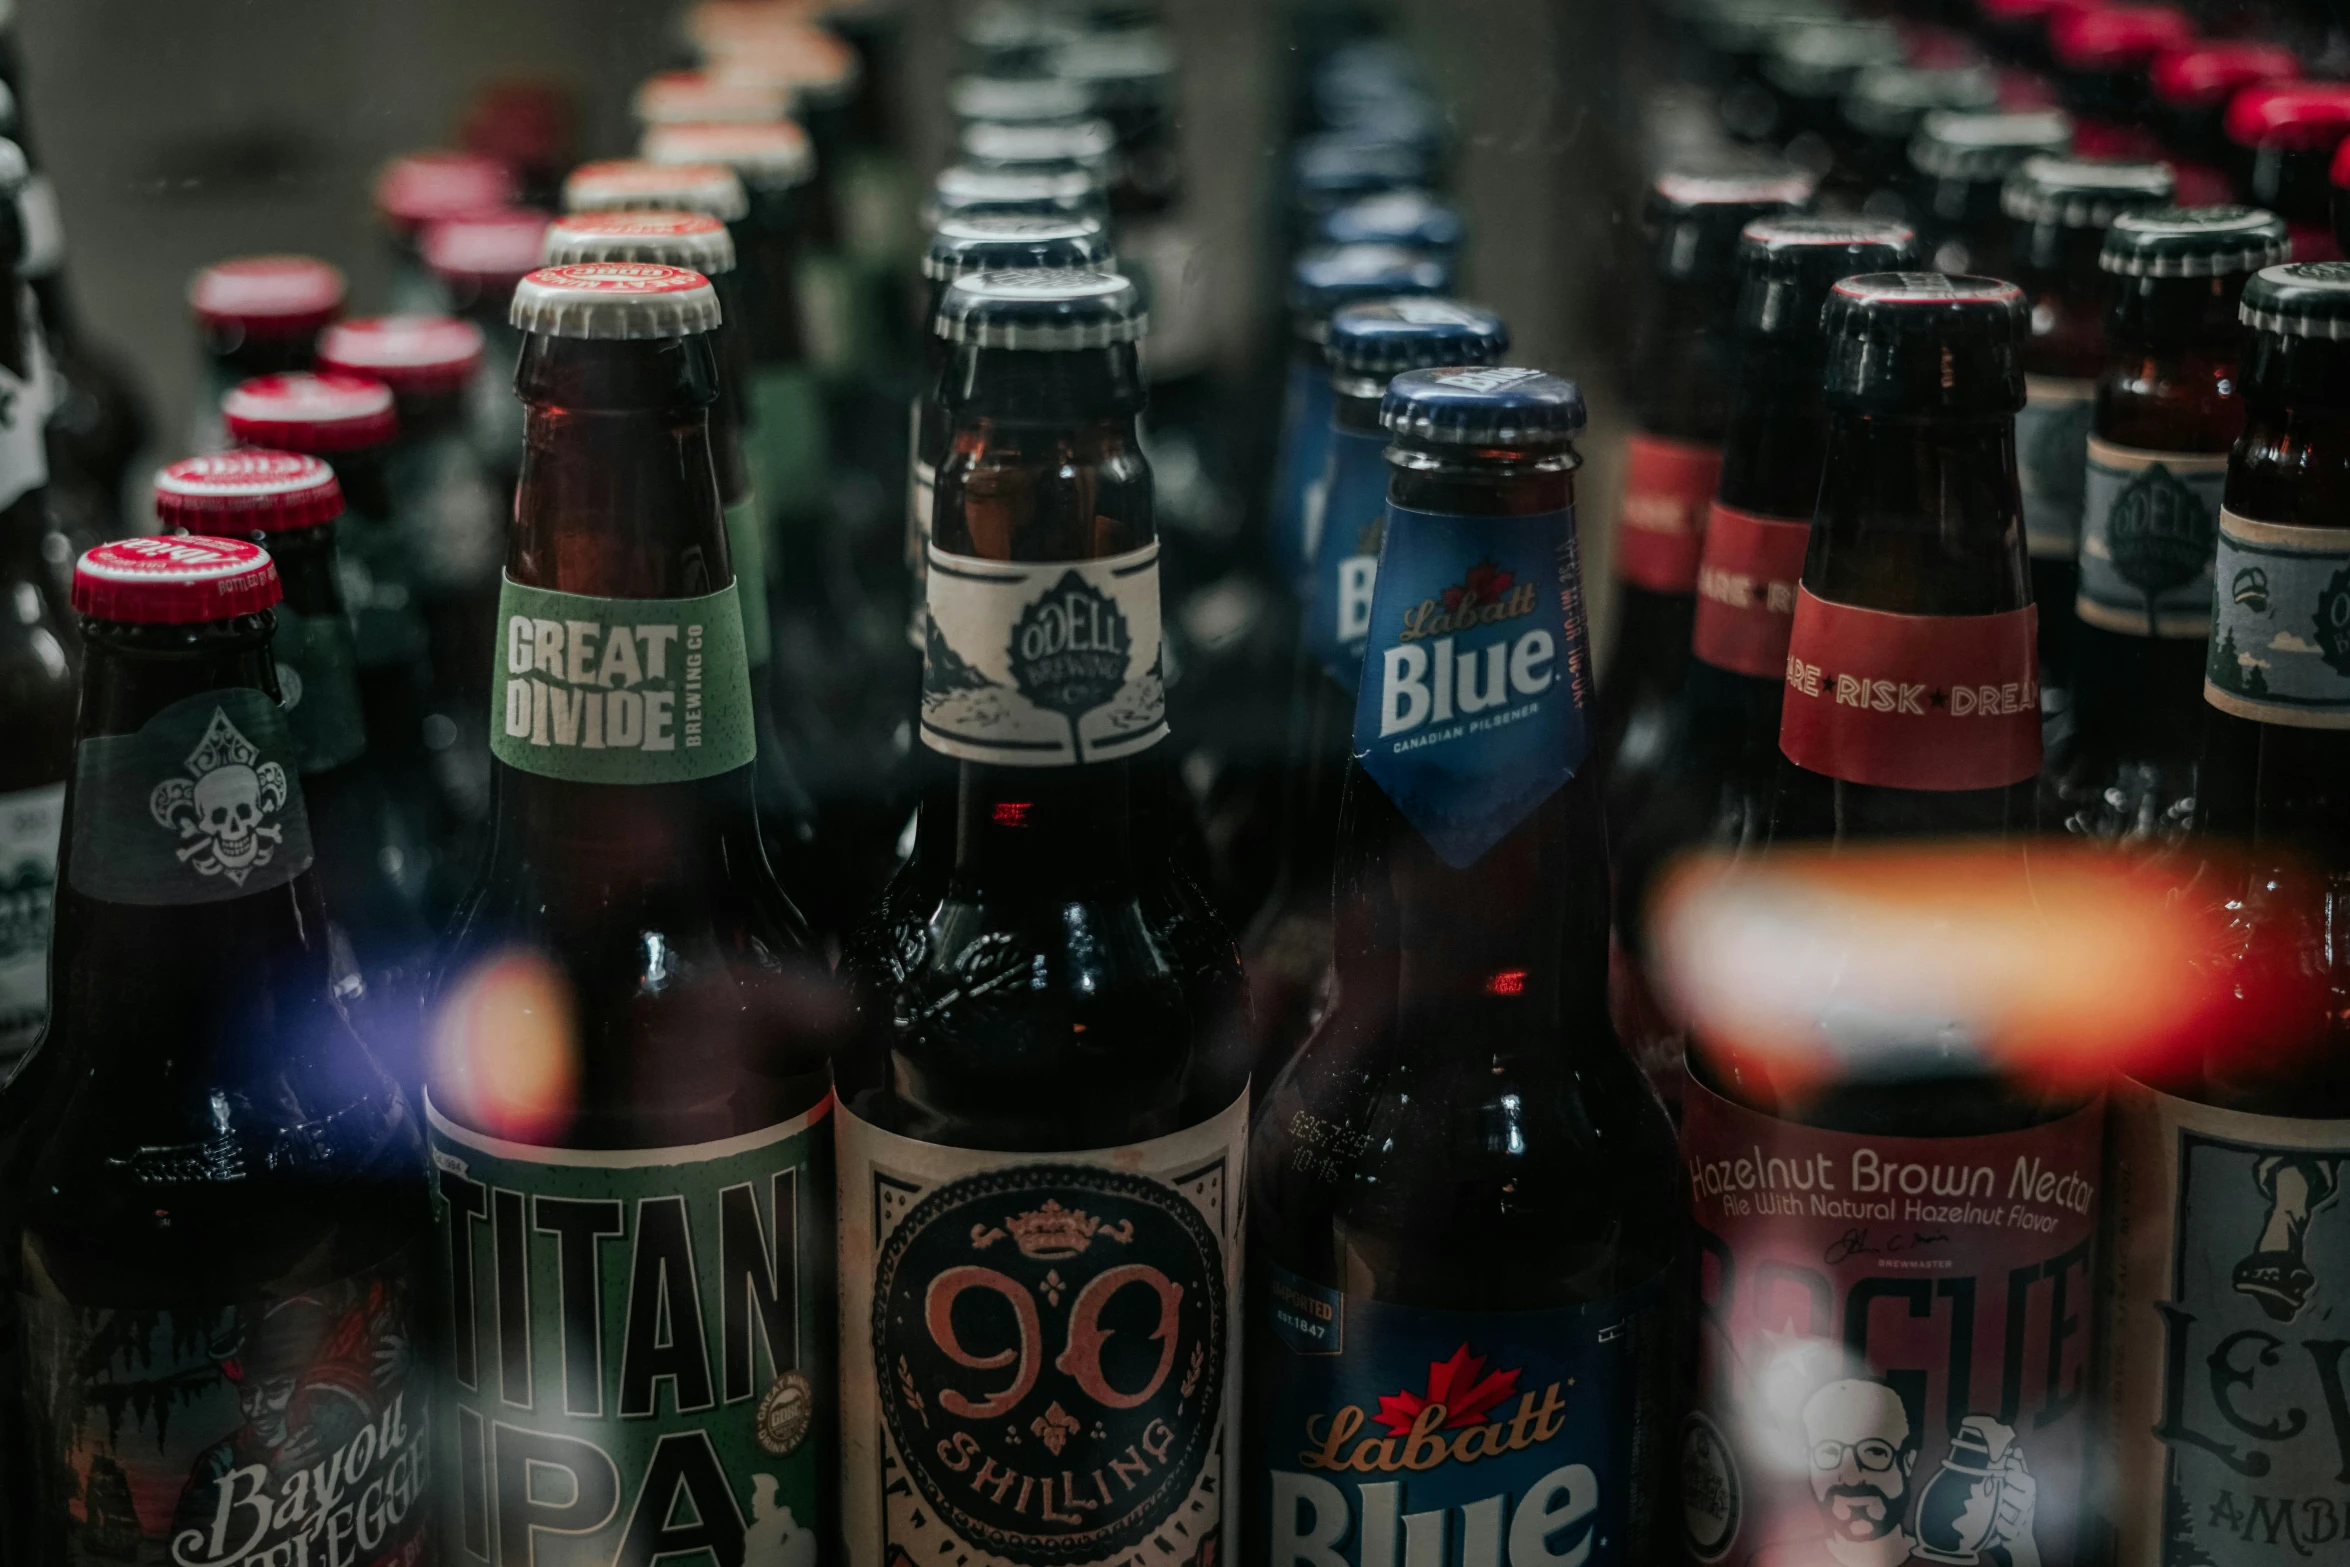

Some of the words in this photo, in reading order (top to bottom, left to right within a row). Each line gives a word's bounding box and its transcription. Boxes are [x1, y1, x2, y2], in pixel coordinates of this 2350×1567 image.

[217, 573, 259, 597] BOTTLED
[1400, 582, 1536, 642] Labatt
[508, 615, 678, 689] GREAT
[687, 624, 703, 652] CO
[1021, 591, 1122, 661] ODELL
[505, 677, 676, 751] DIVIDE
[685, 653, 702, 748] BREWING
[1378, 628, 1556, 739] Blue
[1786, 654, 1822, 697] ARE
[1836, 673, 1927, 717] RISK
[1393, 726, 1464, 754] CANADIAN
[1469, 702, 1540, 735] PILSENER
[1688, 1145, 1834, 1202] Hazelnut
[1851, 1147, 1996, 1198] Brown
[1723, 1193, 1751, 1218] Ale
[1755, 1191, 1804, 1217] With
[1809, 1194, 1897, 1222] Natural
[1904, 1196, 2004, 1226] Hazelnut
[2006, 1204, 2060, 1234] Flavor
[438, 1165, 800, 1418] TITAN
[1272, 1280, 1333, 1320] IMPORTED
[1877, 1258, 1953, 1270] BREWMASTER
[924, 1262, 1185, 1419] 90
[1299, 1381, 1566, 1473] Labatt
[172, 1391, 408, 1567] Bayou
[458, 1402, 754, 1567] IPA
[936, 1417, 1176, 1526] SHILLING
[1268, 1463, 1600, 1567] Blue
